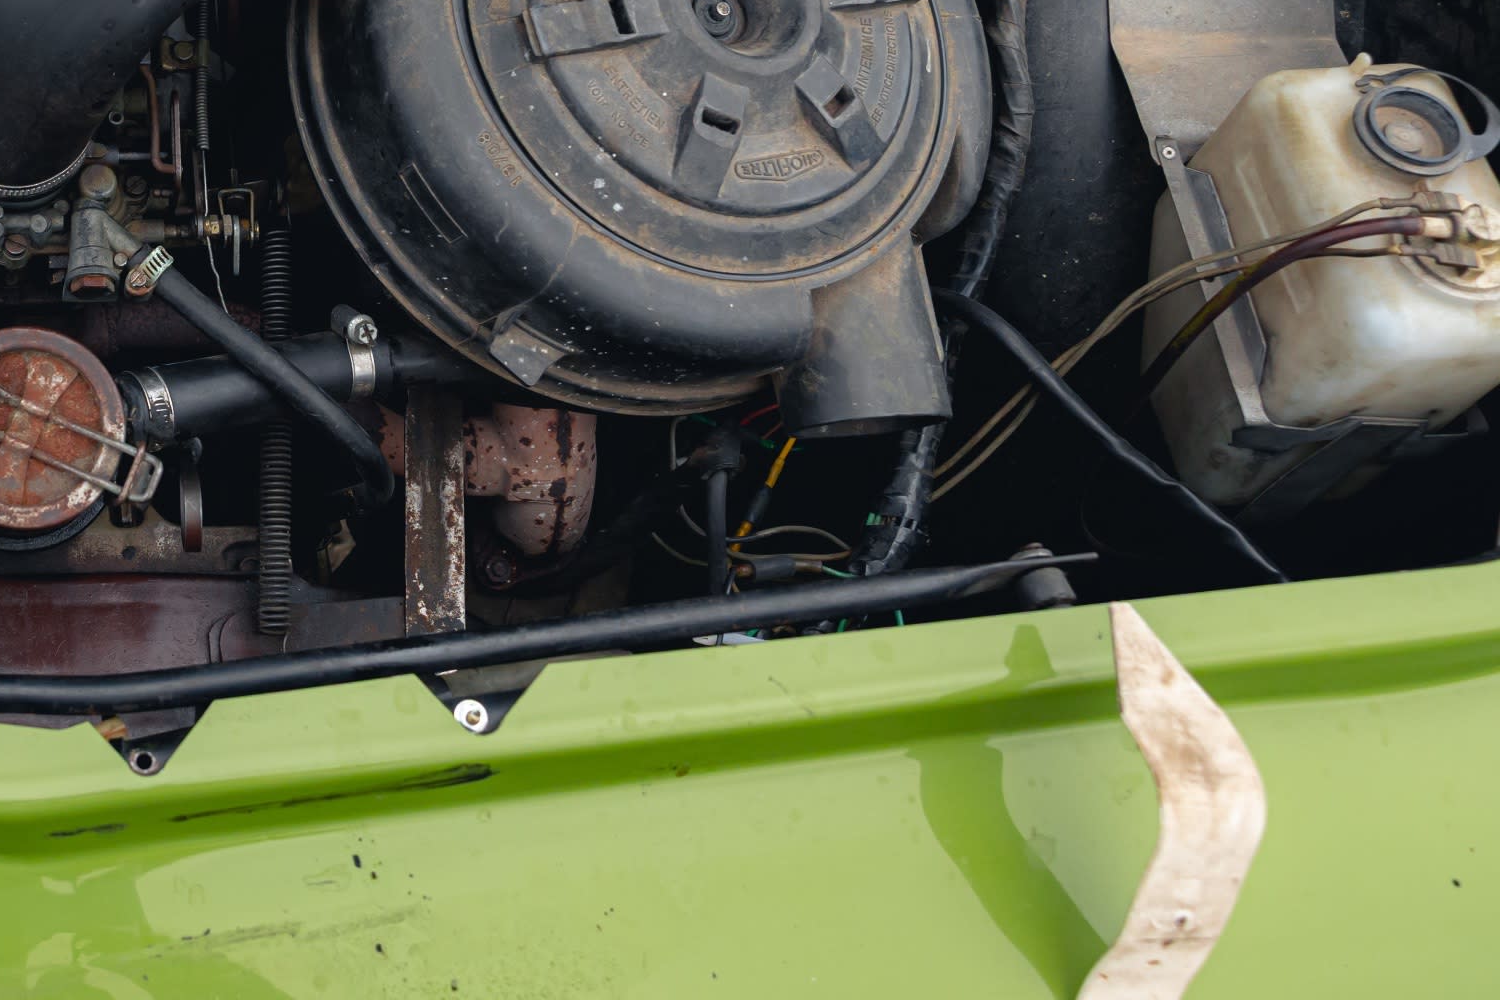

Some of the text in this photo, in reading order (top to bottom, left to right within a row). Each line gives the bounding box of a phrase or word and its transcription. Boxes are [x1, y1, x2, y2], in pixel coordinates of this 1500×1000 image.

[854, 16, 873, 98] AINTENANCE
[603, 64, 666, 132] ENTRETIEN
[877, 73, 895, 109] NOTICE
[611, 110, 650, 148] NOTICE
